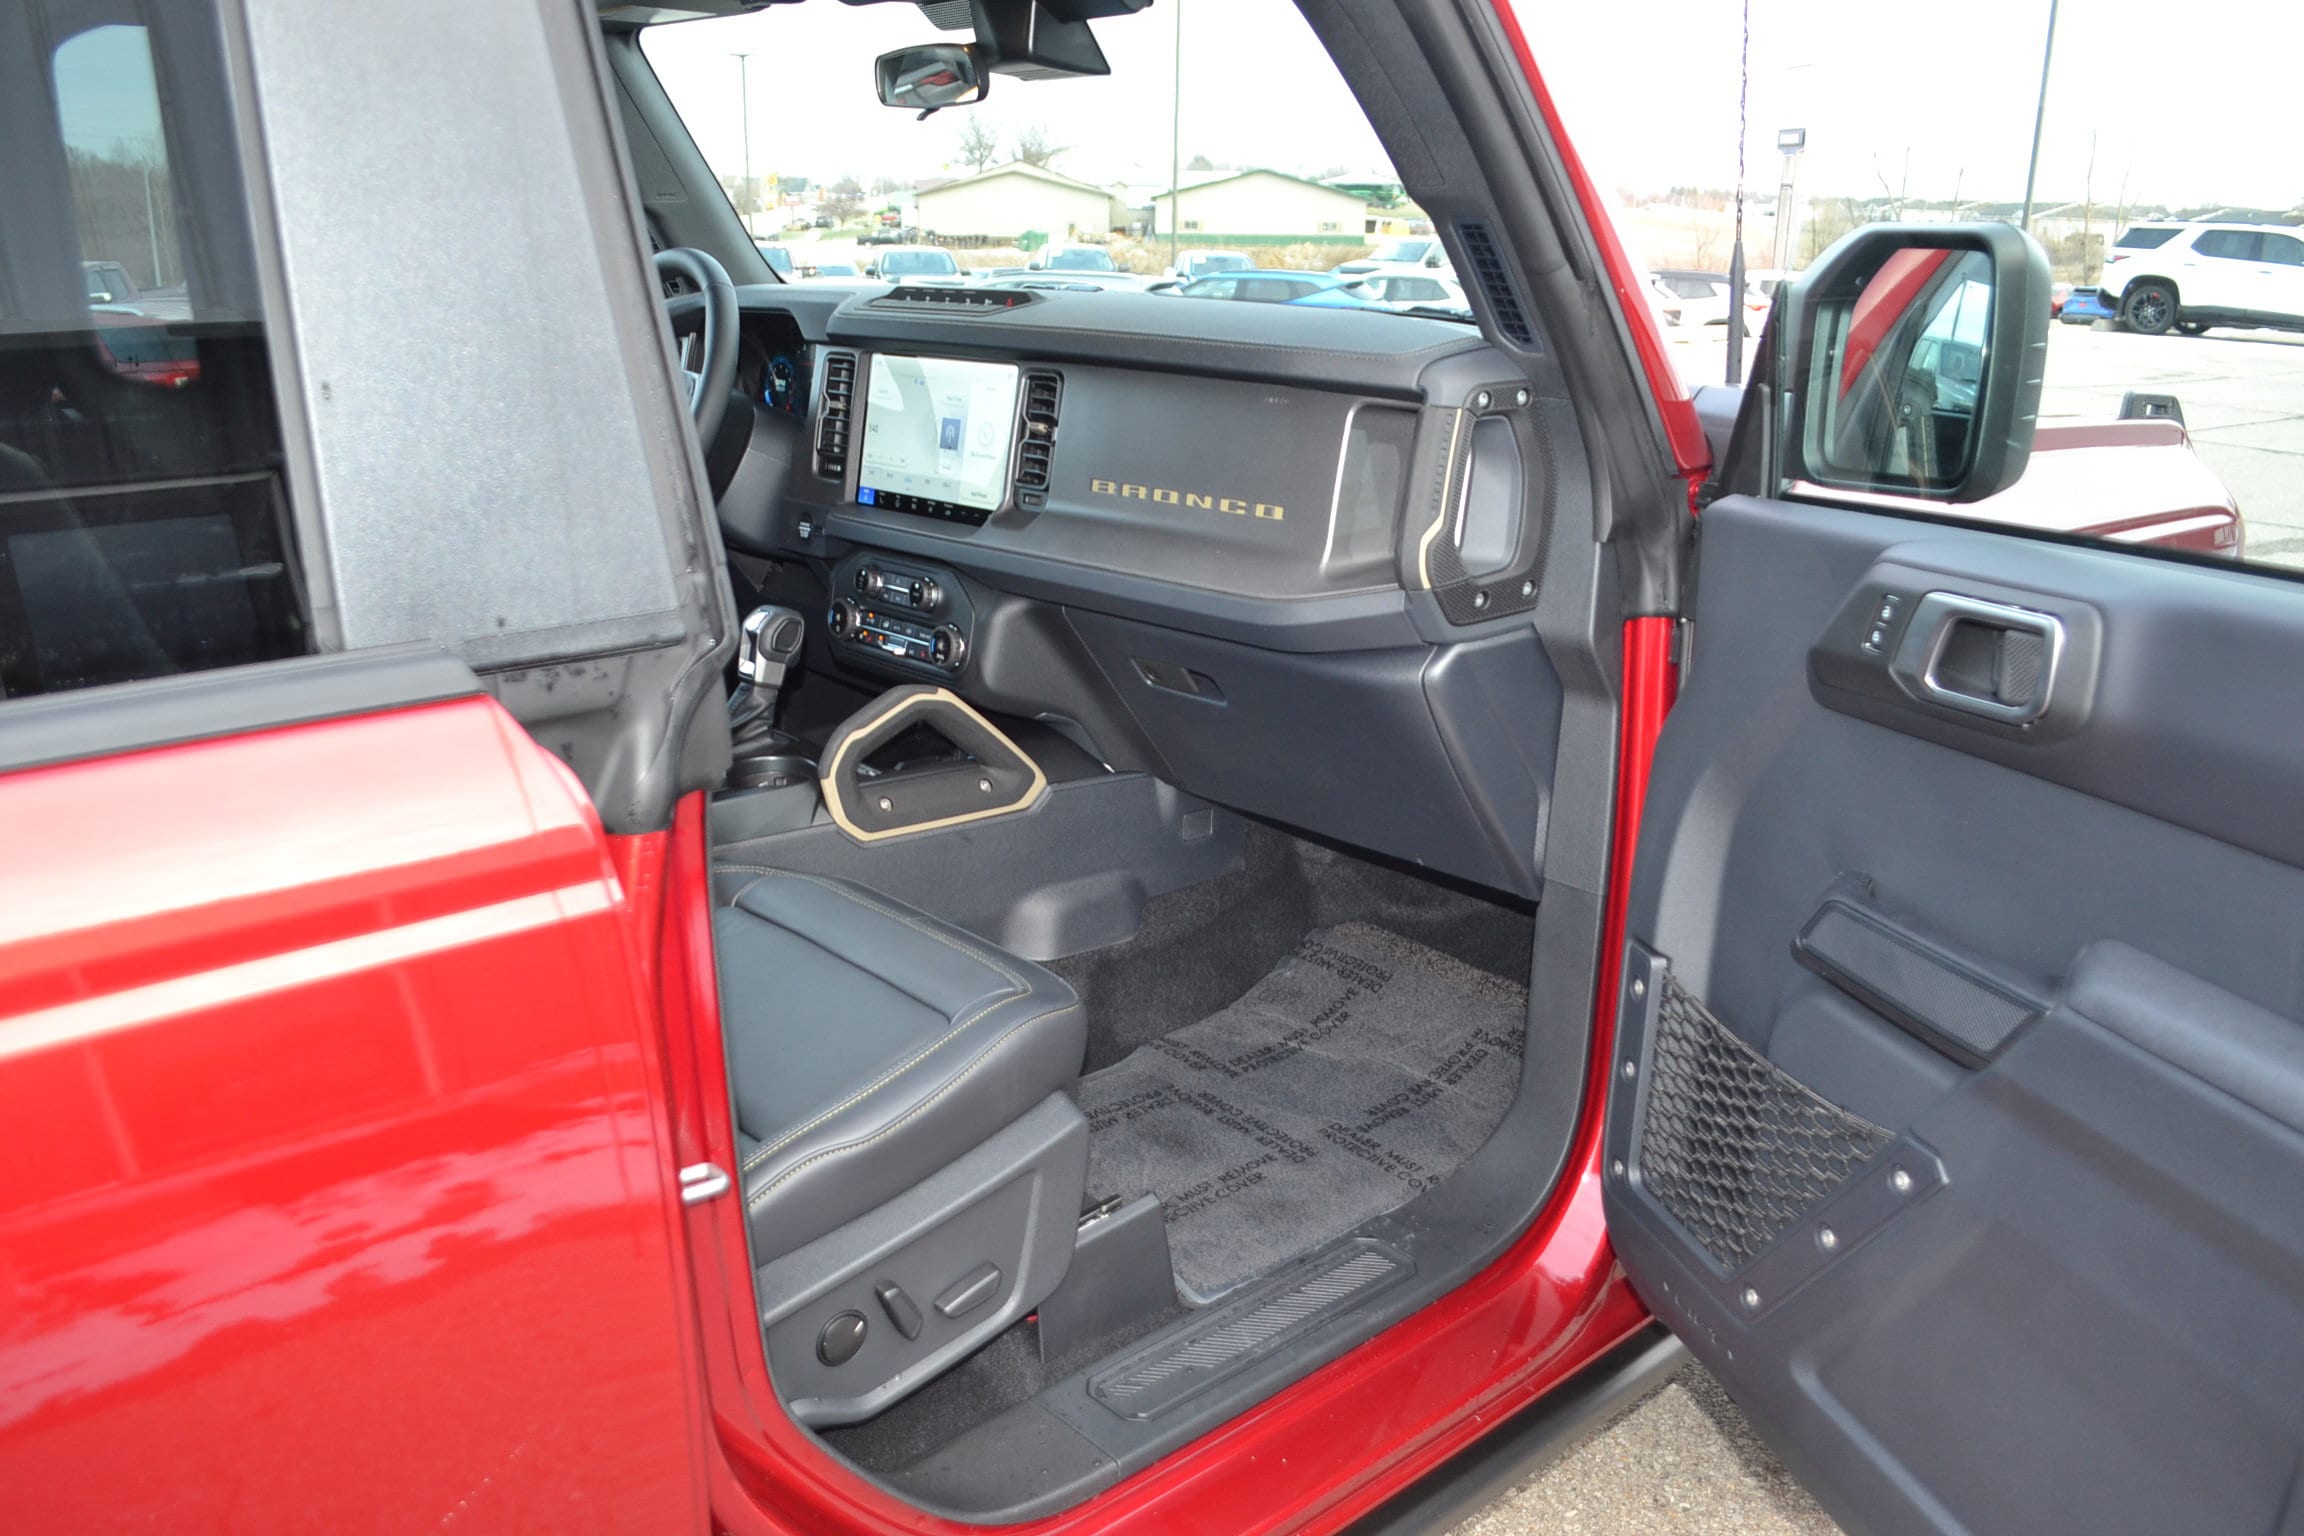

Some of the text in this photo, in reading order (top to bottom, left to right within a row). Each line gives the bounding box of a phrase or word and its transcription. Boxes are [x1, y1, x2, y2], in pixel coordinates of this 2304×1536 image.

[1090, 478, 1285, 521] BRONCO
[1324, 946, 1393, 982] PROTECTIVE
[1337, 965, 1383, 994] DEALER
[1310, 987, 1359, 1027] REMOVE
[1310, 1011, 1350, 1040] COVER
[1444, 1049, 1488, 1085] DEALER
[1089, 1096, 1174, 1132] DEALER MUS
[1412, 1087, 1443, 1107] MUST
[1198, 1090, 1320, 1157] PROTECTIVE COVER
[1217, 1115, 1252, 1134] MUST
[1255, 1136, 1306, 1163] DEALER
[1317, 1128, 1397, 1172] PROTECTIVE
[1328, 1122, 1424, 1172] DEALER MUST
[1176, 1153, 1278, 1201] MUST REMOVE
[1215, 1172, 1267, 1198] COVER
